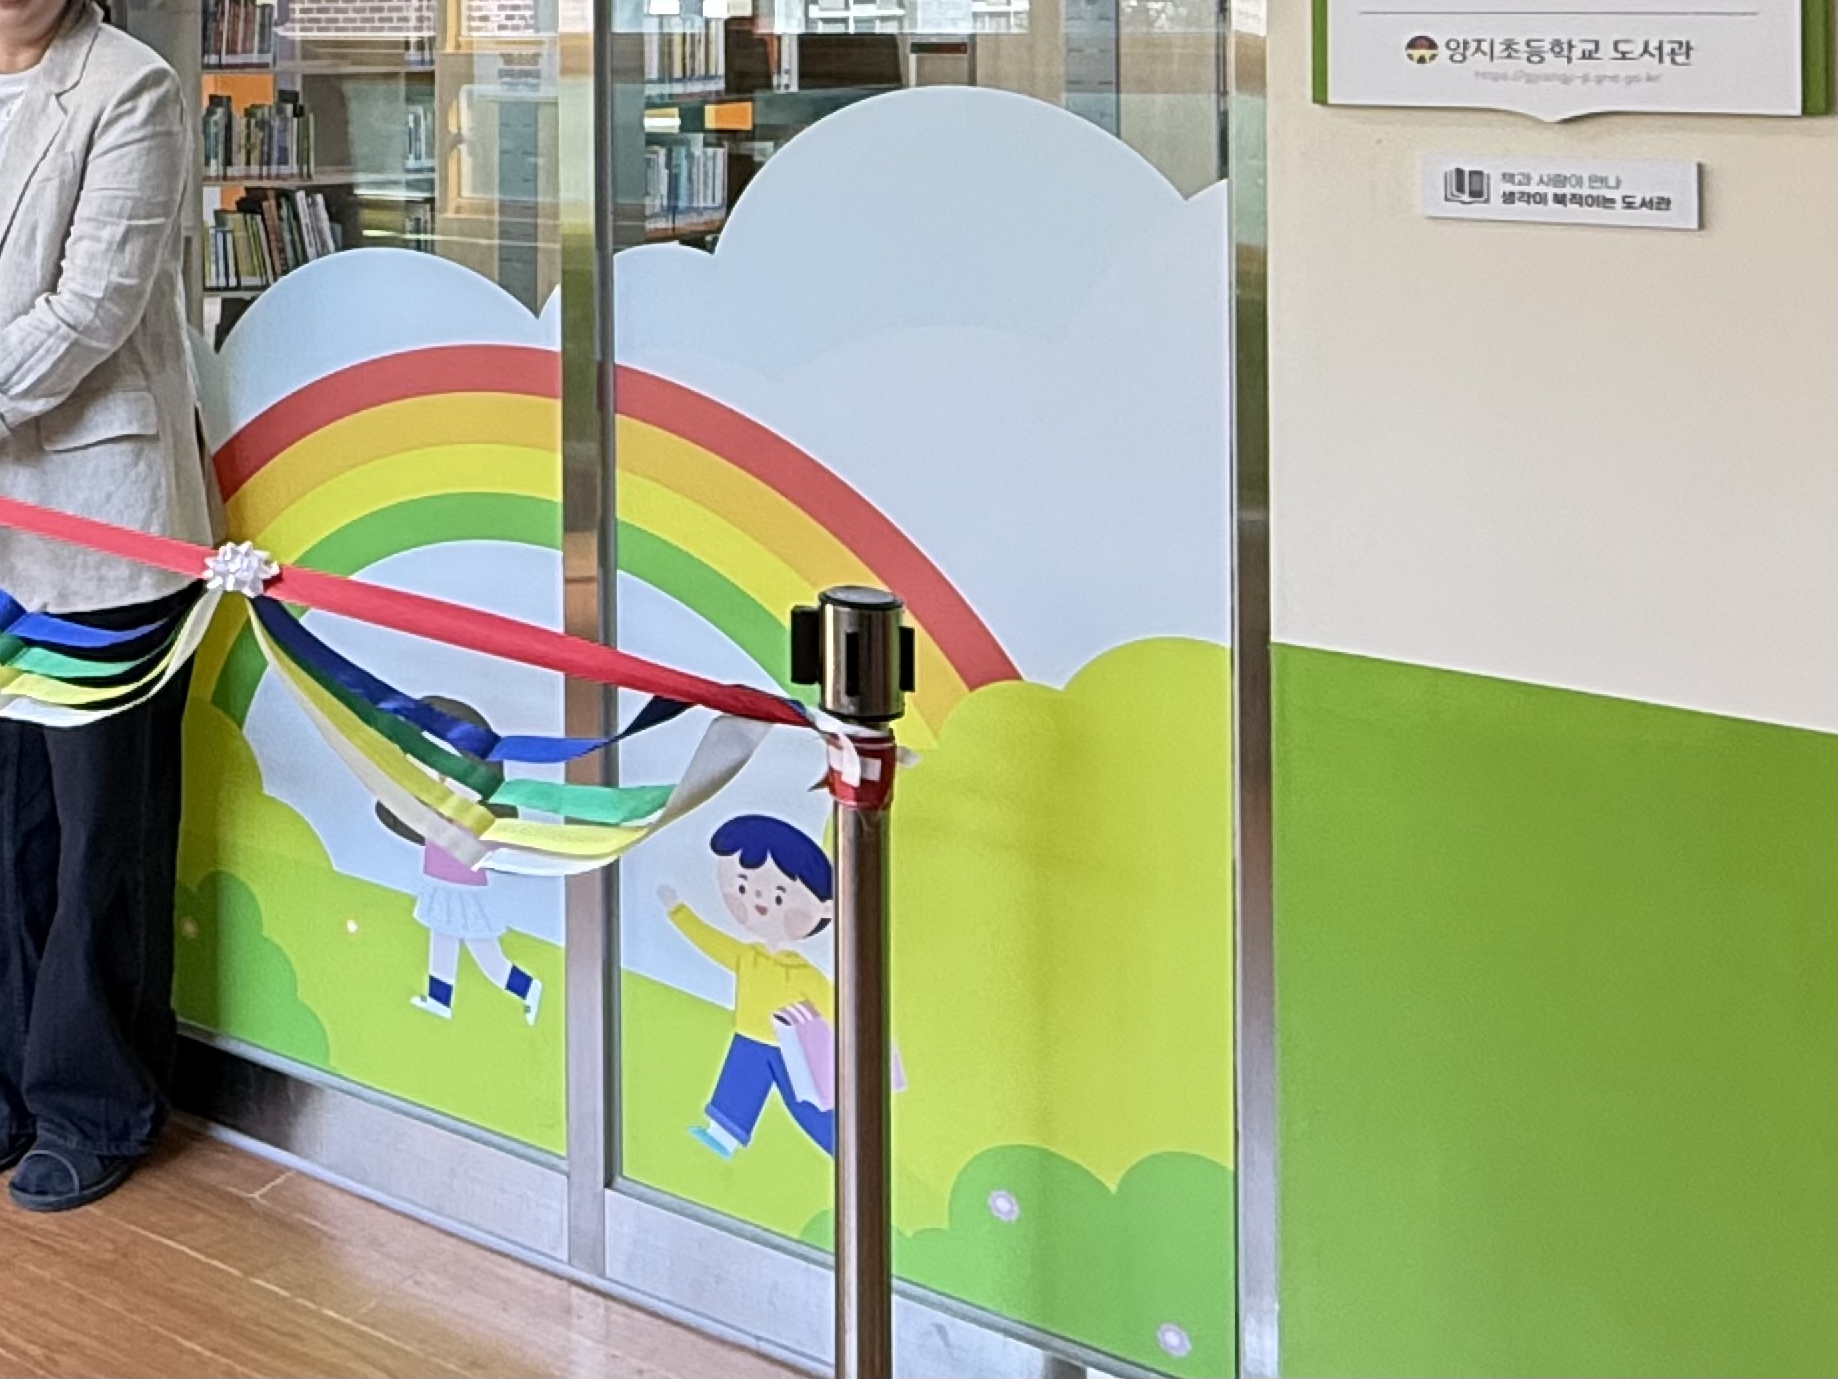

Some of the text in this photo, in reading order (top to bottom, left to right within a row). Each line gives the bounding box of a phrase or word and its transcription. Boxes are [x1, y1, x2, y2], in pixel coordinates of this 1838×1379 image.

[1444, 37, 1695, 67] 양지초등학교 도서관
[1500, 171, 1623, 191] 책과 사람이 만나
[1500, 190, 1672, 212] 생각이 북적이는 도서관
